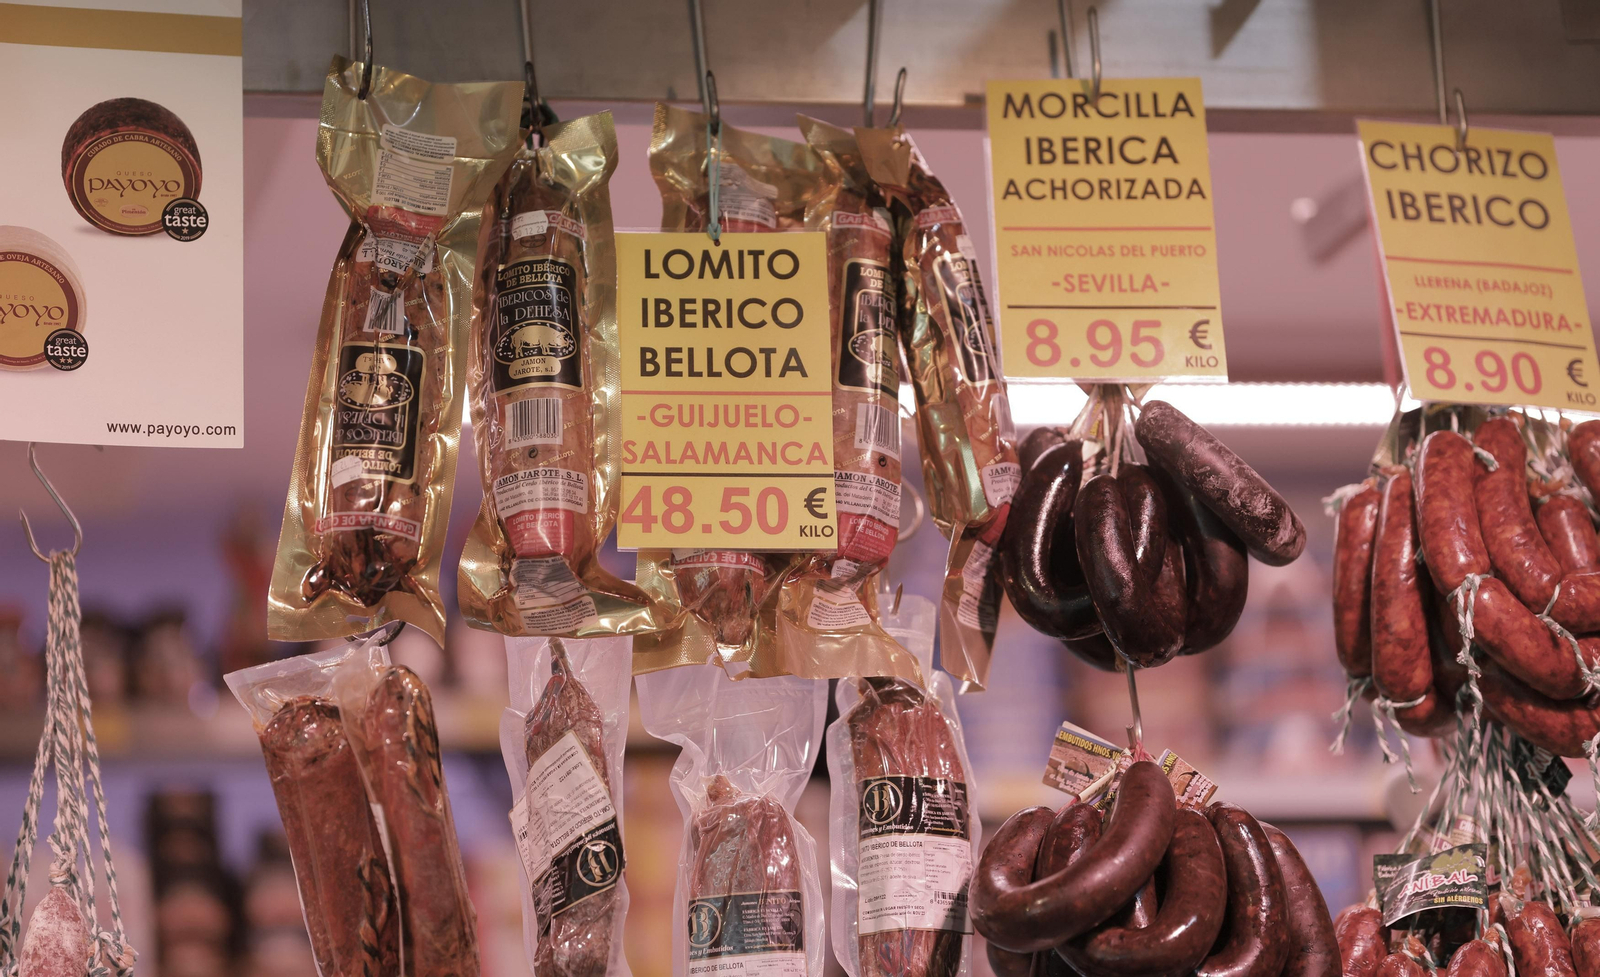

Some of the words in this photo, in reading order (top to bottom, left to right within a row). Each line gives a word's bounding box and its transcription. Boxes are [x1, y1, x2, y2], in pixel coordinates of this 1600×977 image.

[1003, 92, 1195, 119] MORCILLA
[87, 139, 112, 158] CURADO
[113, 135, 123, 143] DE
[124, 134, 149, 142] CABRA
[150, 138, 182, 161] ARTESANO
[1025, 136, 1179, 165] IBERICA
[1369, 139, 1548, 181] CHORIZO
[88, 177, 180, 199] PAYOYO
[1002, 178, 1207, 201] ACHORIZADA
[173, 206, 196, 216] great
[1385, 188, 1550, 230] IBERICO
[164, 214, 207, 228] taste
[1011, 244, 1043, 257] SAN
[1048, 244, 1116, 257] NICOLAS
[1121, 244, 1147, 257] DEL
[1151, 244, 1207, 257] PUERTO
[6, 253, 30, 262] OVEJA
[31, 258, 65, 284] ARTESANO
[497, 264, 531, 281] LOMITO
[532, 260, 570, 276] IBÉRICO
[644, 248, 800, 280] LOMITO
[506, 277, 517, 288] DE
[519, 273, 563, 284] BELLOTA
[1052, 273, 1170, 293] -SEVILLA-
[1414, 275, 1472, 291] LLERENA
[1477, 278, 1554, 300] (BADAJOZ)
[500, 289, 552, 308] IBERICOS
[556, 291, 569, 303] de
[500, 313, 509, 326] la
[514, 305, 570, 321] DEHESA
[641, 297, 804, 329] IBERICO
[1396, 301, 1583, 333] -EXTREMADURA-
[46, 344, 87, 357] taste
[55, 337, 77, 346] great
[1025, 318, 1166, 368] 8.95
[1188, 319, 1213, 350] €
[513, 366, 543, 377] JAROTE,
[521, 357, 546, 366] JAMON
[639, 346, 809, 379] BELLOTA
[1185, 355, 1219, 368] KILO
[1423, 346, 1542, 396] 8.90
[1566, 358, 1589, 388] €
[1566, 391, 1597, 406] KILO
[637, 403, 813, 429] -GUIJUELO-
[106, 422, 236, 438] www.payoyo.com
[377, 451, 393, 460] DE
[622, 440, 829, 466] SALAMANCA
[362, 460, 402, 474] LOMITO
[520, 469, 564, 479] JAROTE,
[342, 515, 356, 525] DE
[621, 485, 789, 535] 48.50
[803, 486, 829, 520] €
[799, 524, 834, 538] KILO
[722, 552, 737, 563] DE
[1059, 730, 1093, 751] EMBUTIDOS
[1092, 743, 1111, 758] HNOS.
[871, 841, 889, 851] IBERICO
[899, 840, 923, 848] BELLOTA
[1396, 869, 1479, 900] ANÍBAL
[1446, 894, 1484, 905] ALÉRGENOS
[718, 962, 744, 971] BELLOTA
